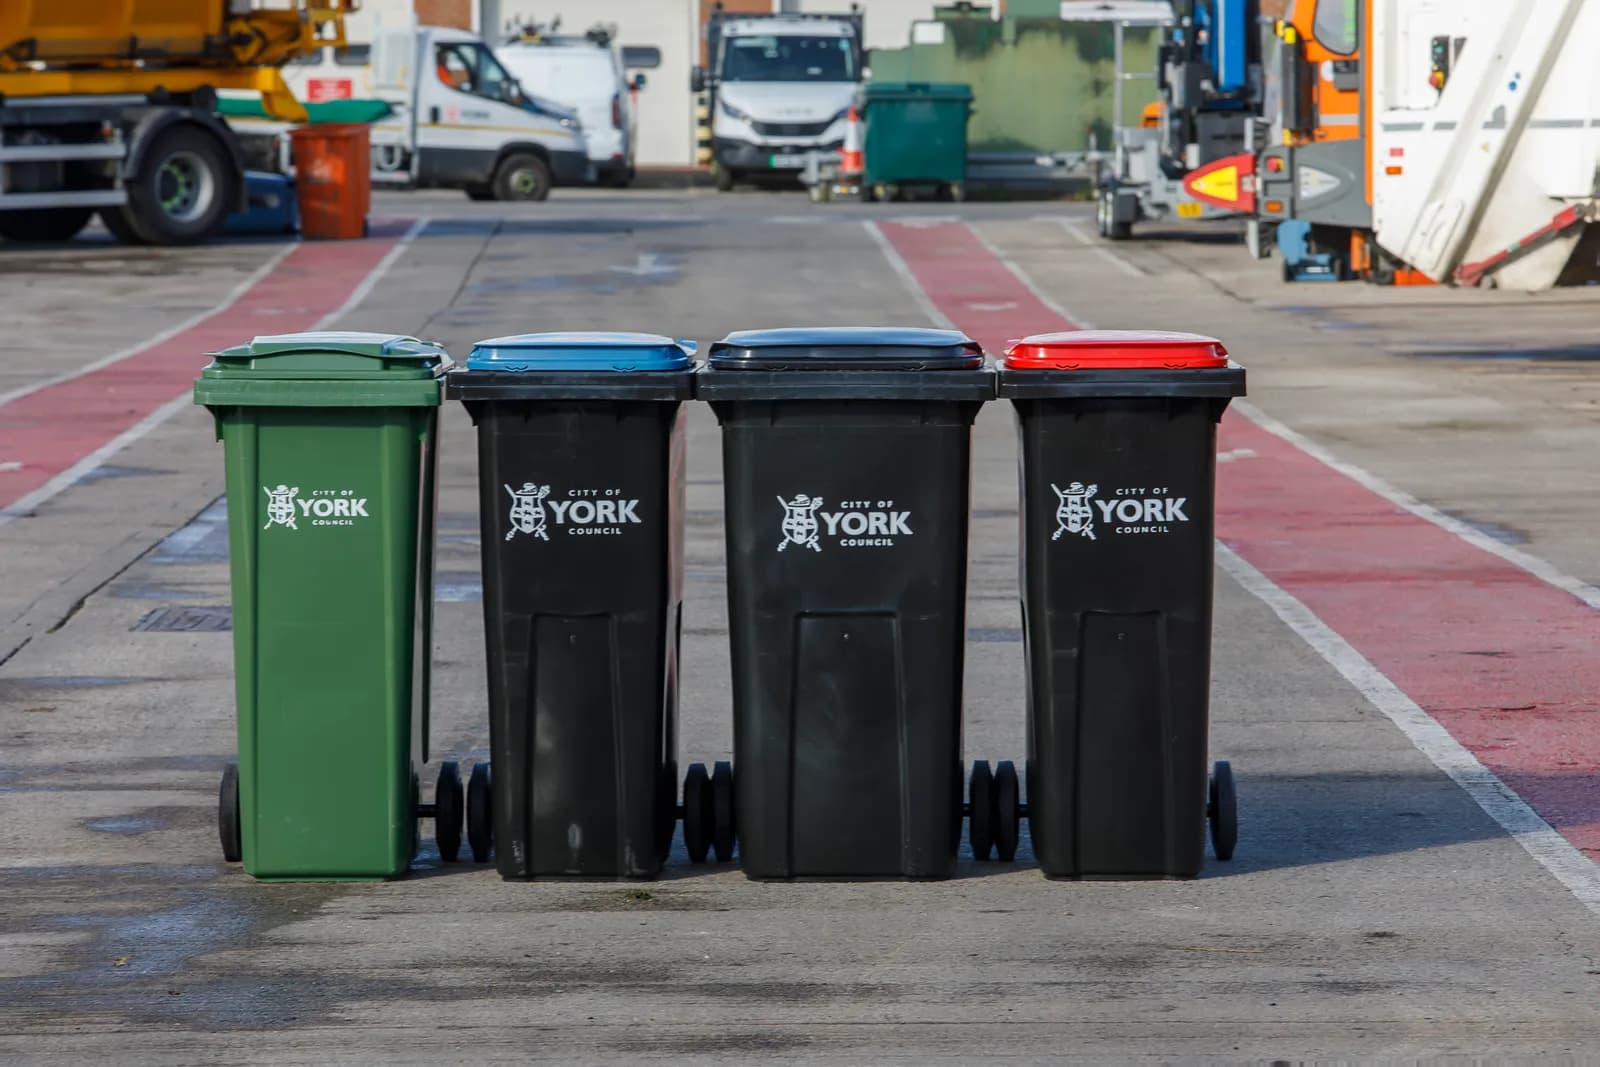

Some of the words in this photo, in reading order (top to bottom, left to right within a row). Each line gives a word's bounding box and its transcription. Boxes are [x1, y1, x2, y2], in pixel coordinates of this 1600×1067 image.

[568, 489, 598, 497] CITY
[605, 488, 620, 496] OF
[1115, 488, 1146, 496] CITY
[1152, 487, 1168, 495] OF
[297, 498, 370, 517] YORK
[841, 501, 871, 509] CITY
[877, 500, 893, 508] OF
[547, 500, 641, 524] YORK
[1095, 498, 1189, 523] YORK
[820, 511, 913, 536] YORK
[568, 527, 622, 535] COUNCIL
[1115, 526, 1169, 534] COUNCIL
[840, 538, 894, 547] COUNCIL
